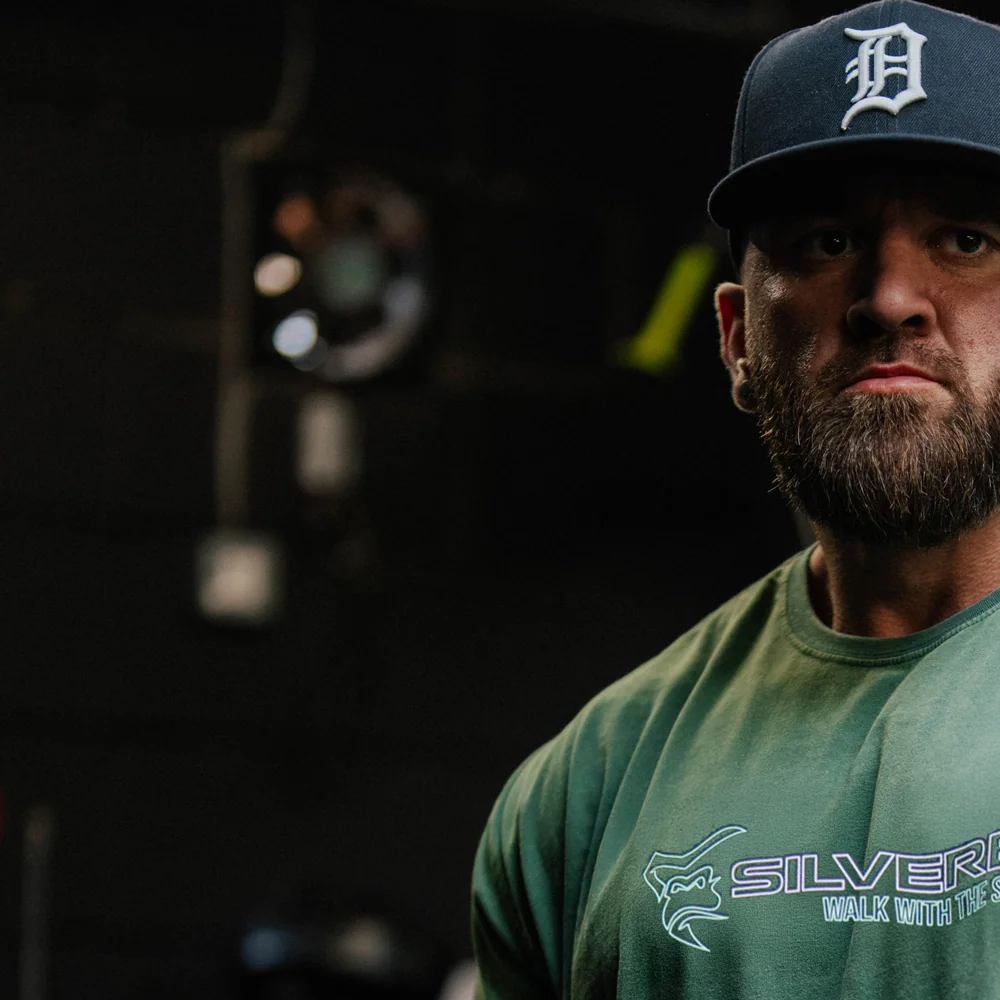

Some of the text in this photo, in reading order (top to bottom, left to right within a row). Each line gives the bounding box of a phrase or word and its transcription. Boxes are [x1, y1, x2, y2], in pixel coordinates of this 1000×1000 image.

[841, 22, 928, 130] D
[822, 895, 890, 922] WALK
[894, 897, 952, 927] WITH
[955, 880, 988, 920] THE
